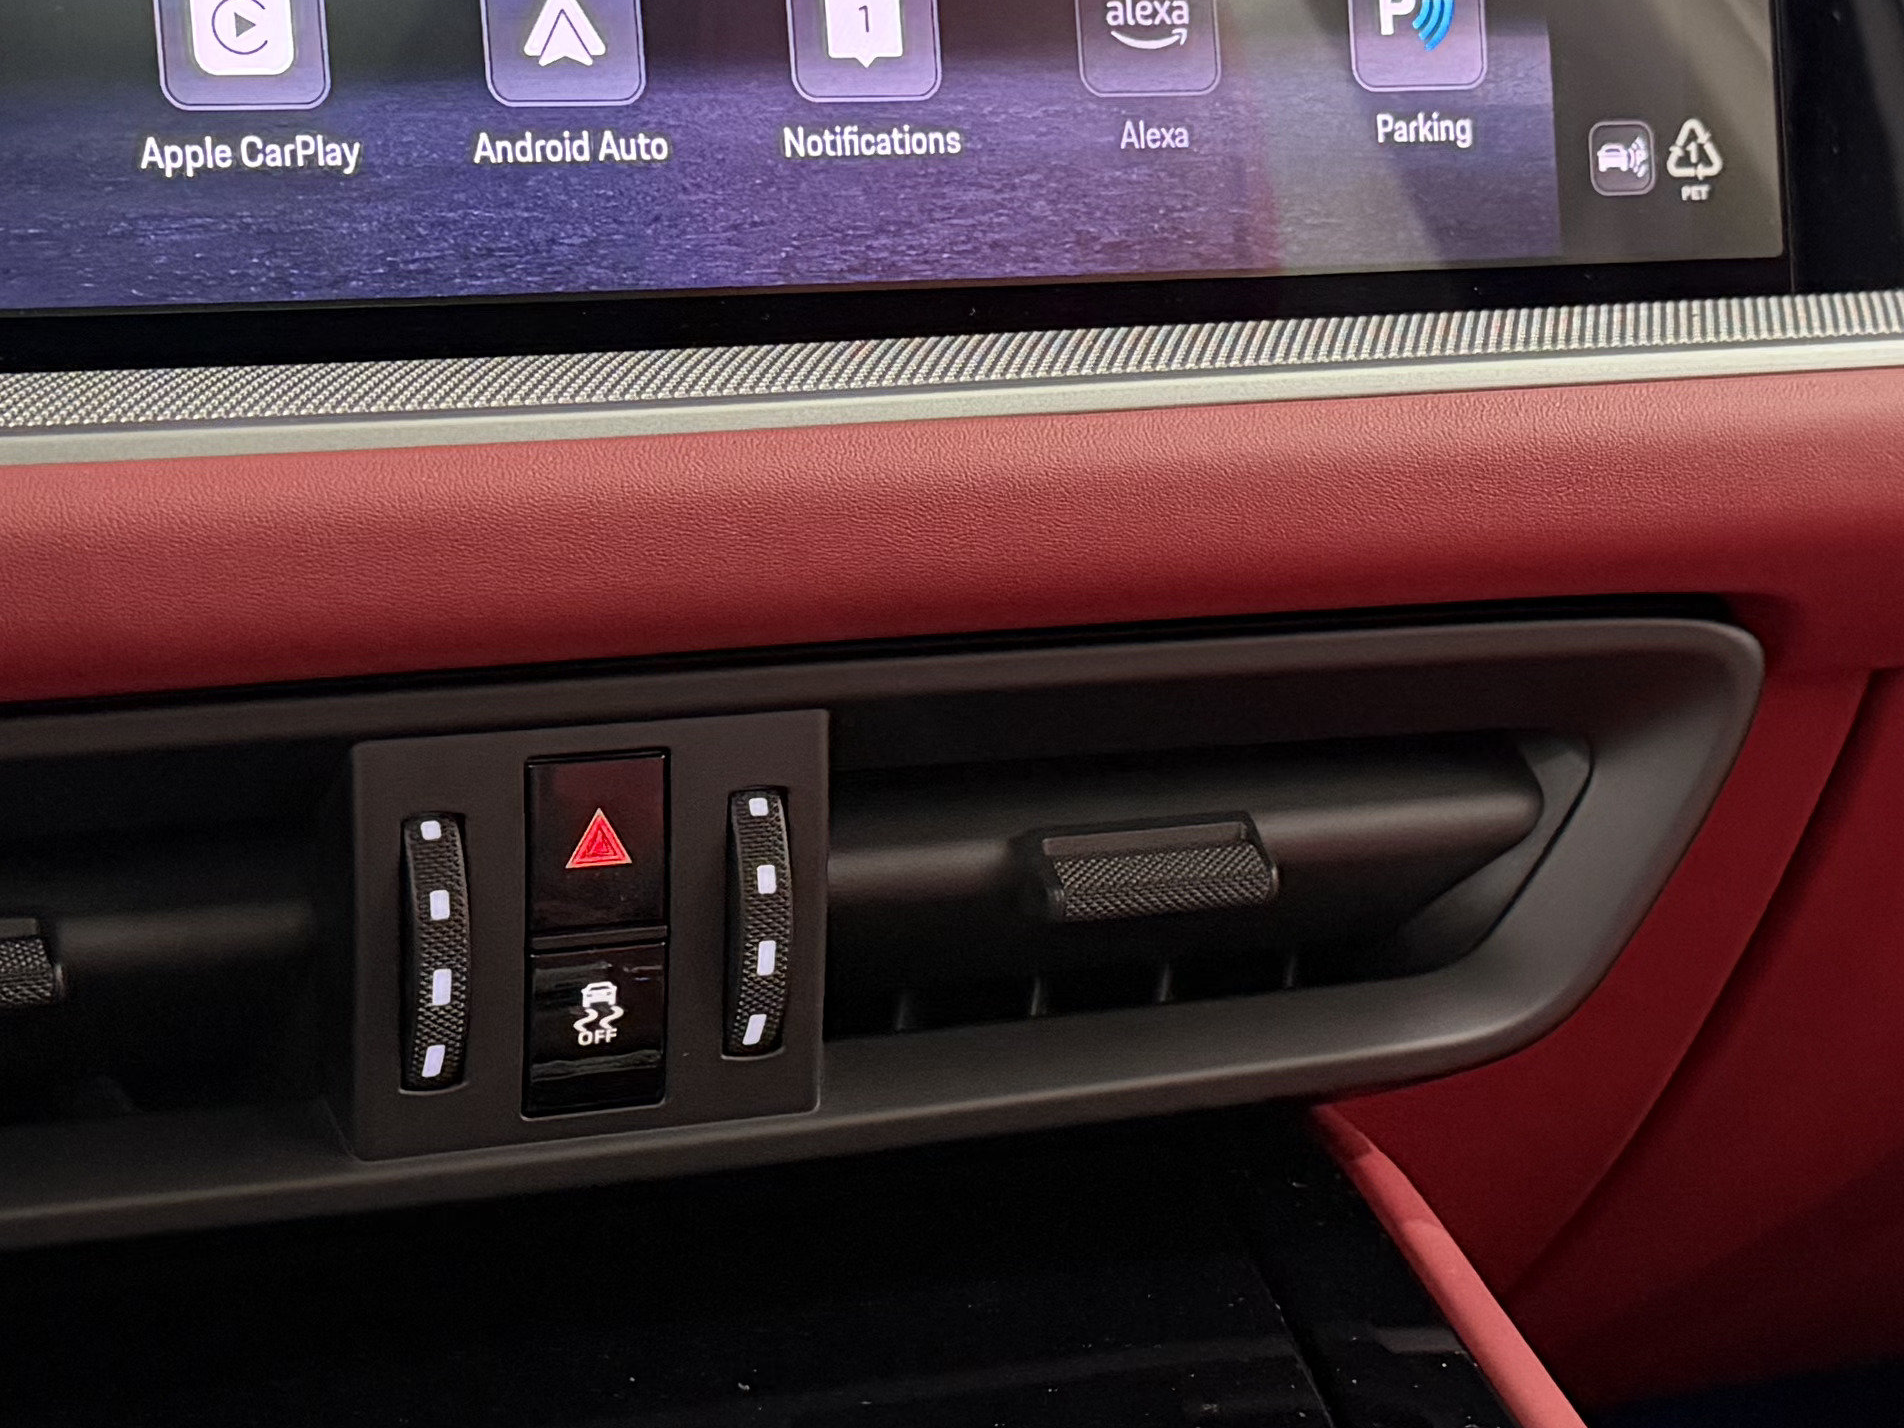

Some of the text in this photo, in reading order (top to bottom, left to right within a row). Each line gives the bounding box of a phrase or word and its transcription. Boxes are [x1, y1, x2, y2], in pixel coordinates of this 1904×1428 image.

[858, 5, 870, 33] 1
[784, 125, 961, 157] Notifications
[1121, 120, 1188, 148] Alexa
[1377, 112, 1472, 148] Parking
[141, 135, 360, 178] Apple CarPlay
[474, 131, 668, 163] Android Auto
[1681, 184, 1711, 201] PET
[577, 1028, 617, 1045] OFF
